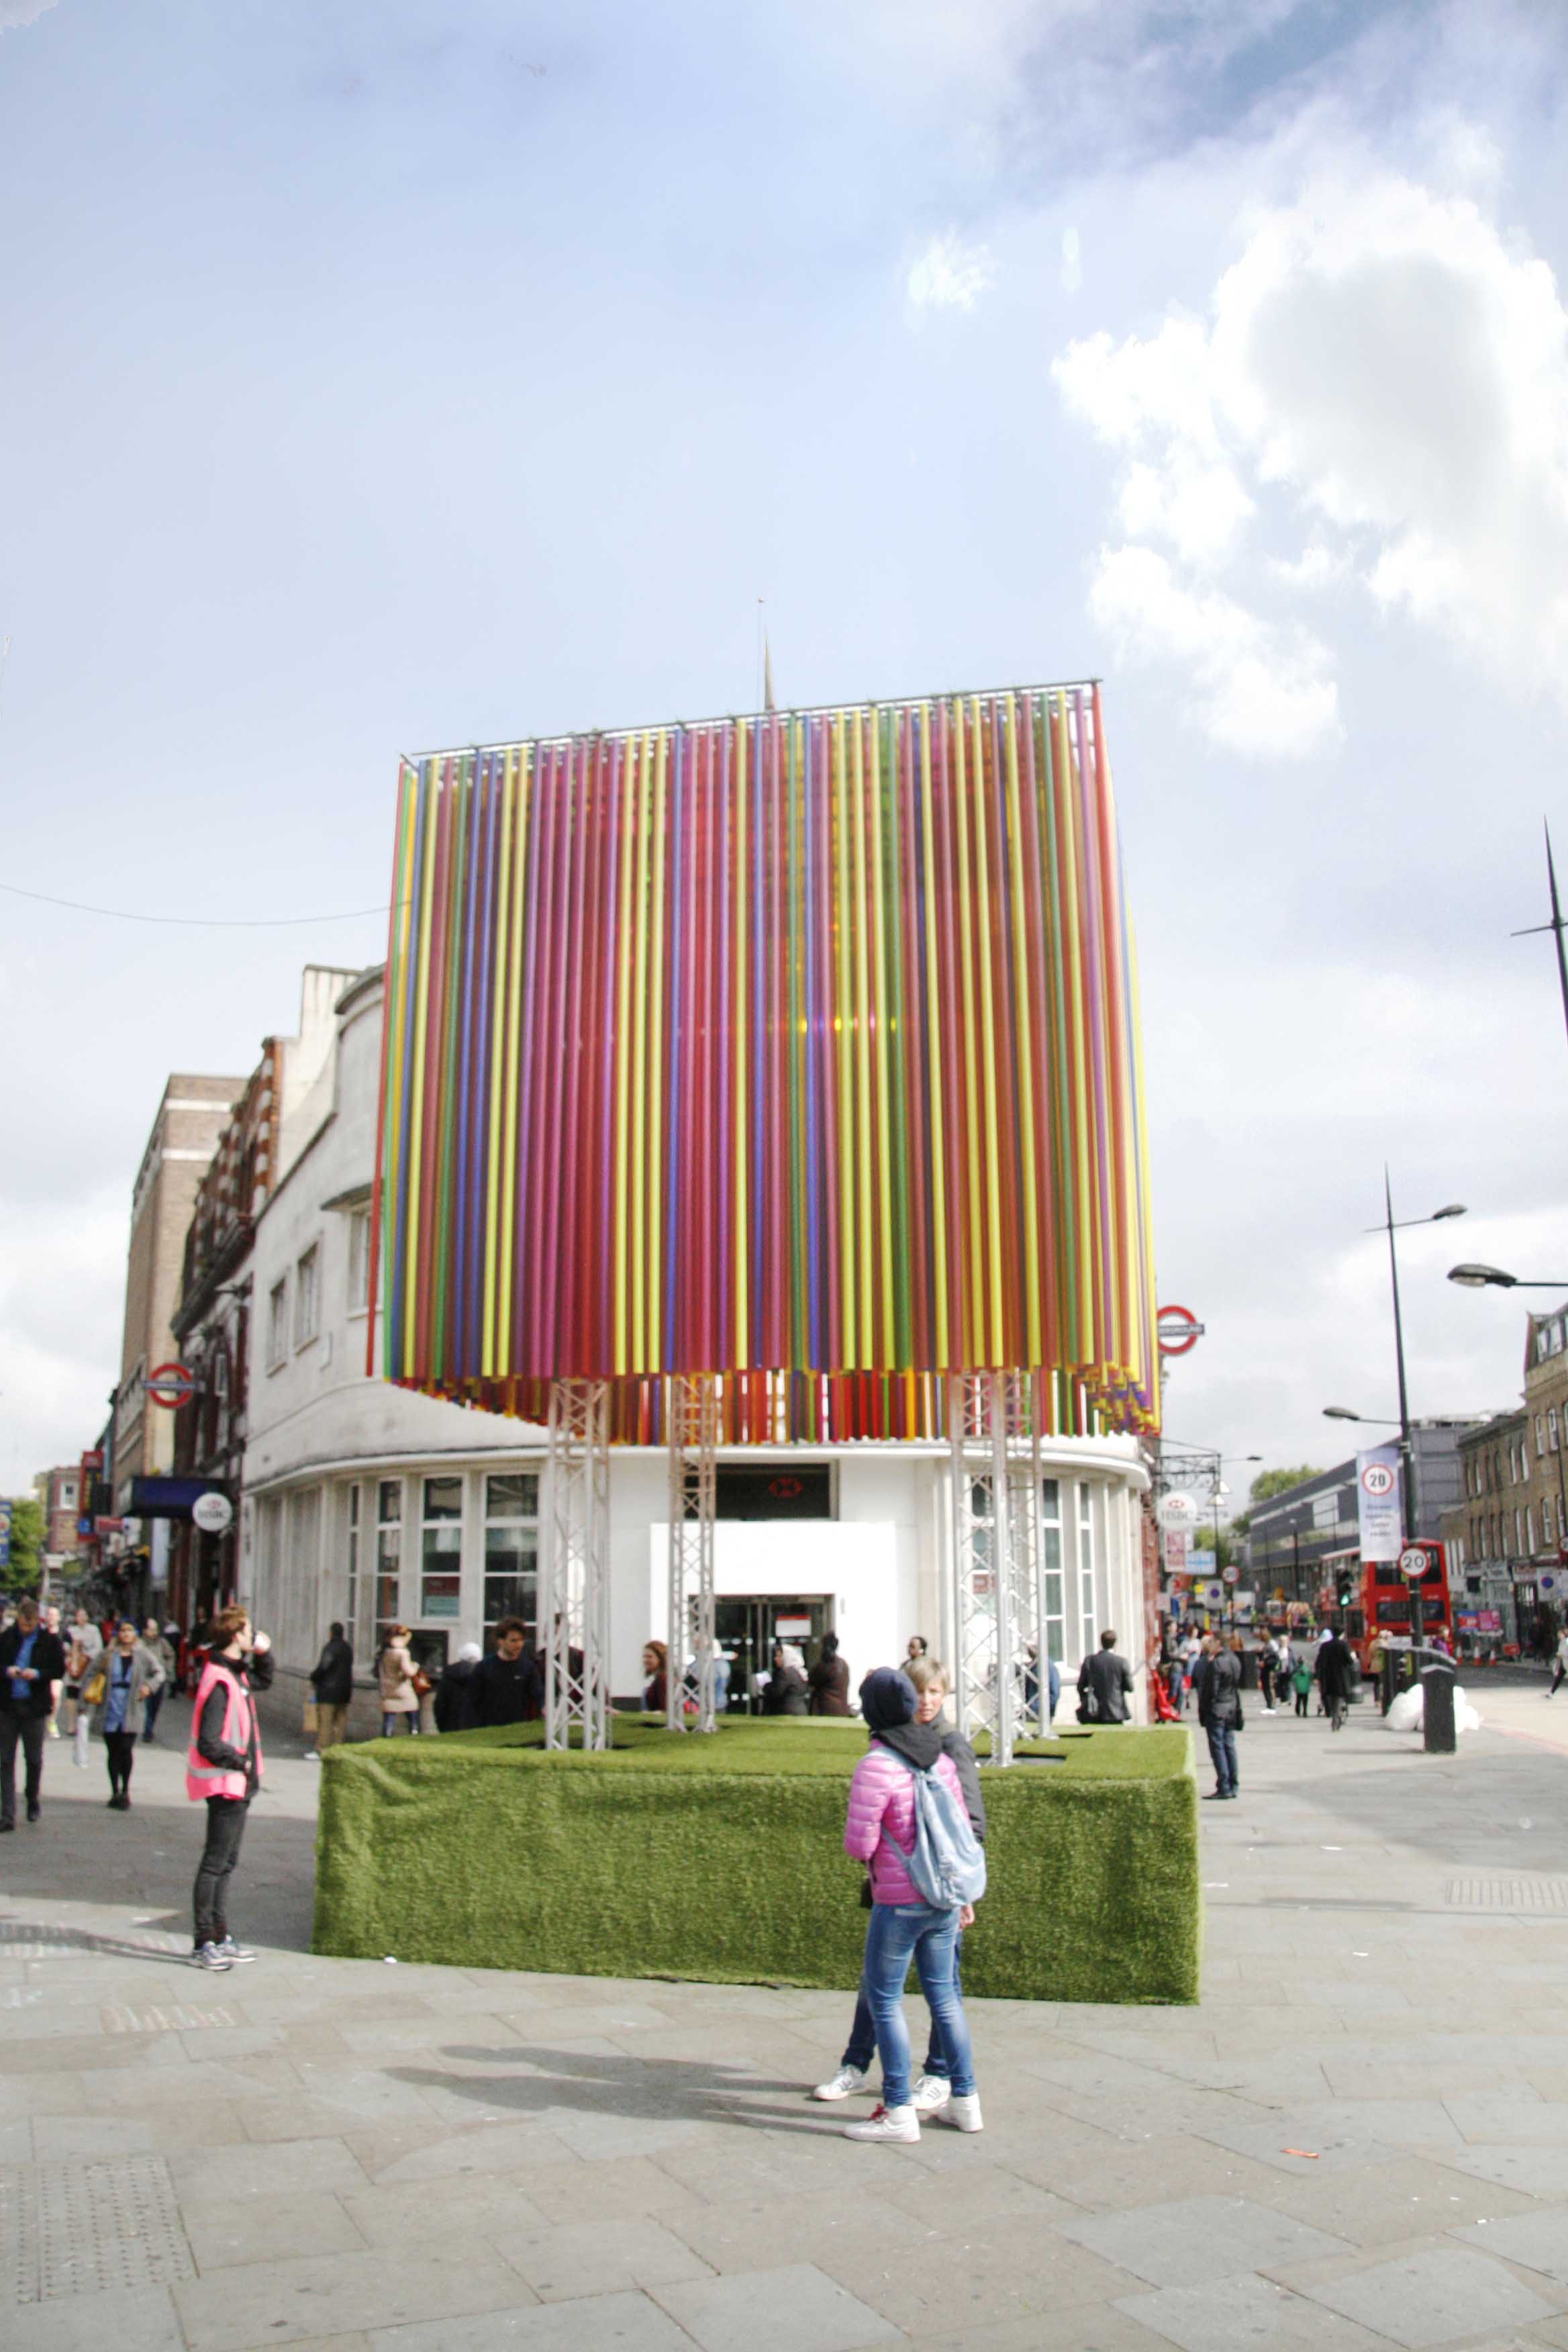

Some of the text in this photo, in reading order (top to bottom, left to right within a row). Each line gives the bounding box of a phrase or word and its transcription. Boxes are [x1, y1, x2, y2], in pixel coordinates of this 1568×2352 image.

[1369, 1474, 1386, 1487] 20
[1160, 1510, 1194, 1520] HSBC
[1404, 1556, 1424, 1569] 20
